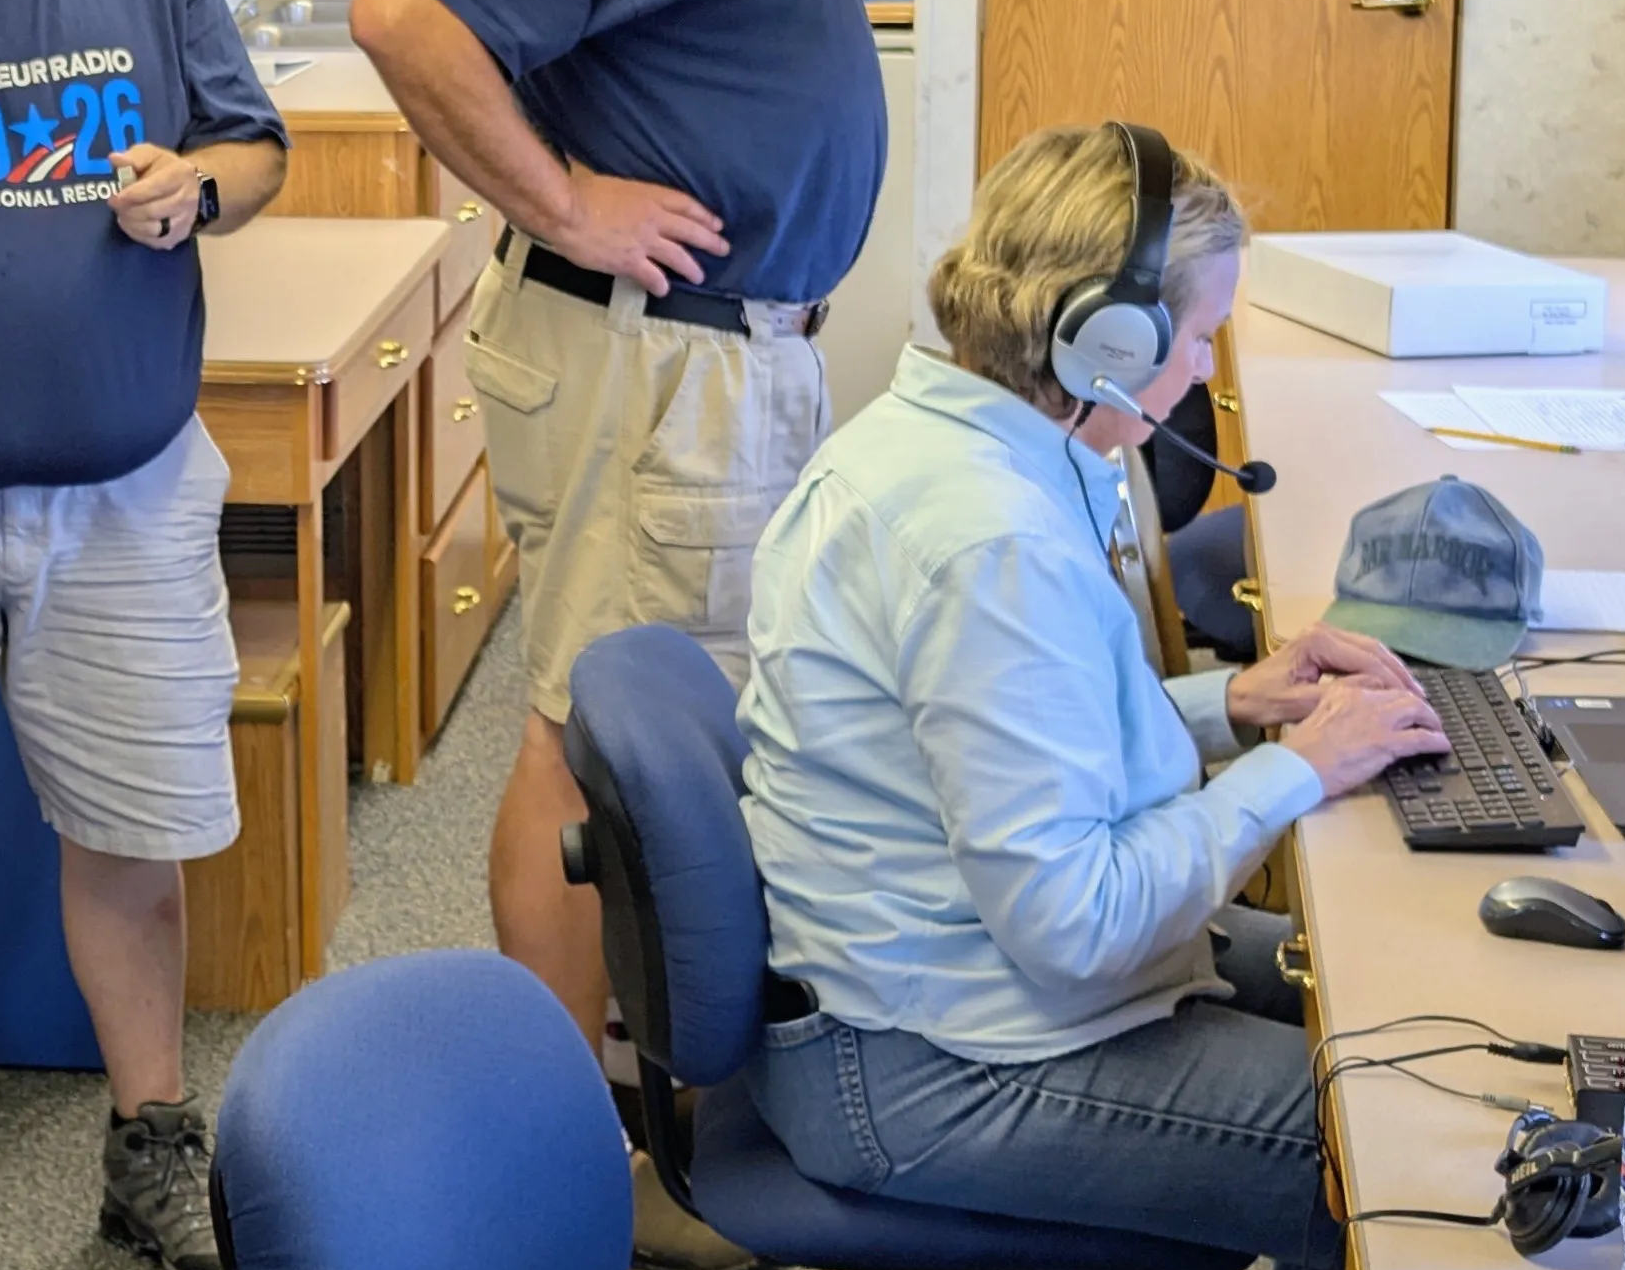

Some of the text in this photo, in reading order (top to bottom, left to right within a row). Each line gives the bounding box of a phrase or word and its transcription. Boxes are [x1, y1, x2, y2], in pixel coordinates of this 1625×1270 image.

[49, 47, 135, 82] RADIO
[60, 78, 145, 176] 26
[61, 181, 123, 205] RESOU
